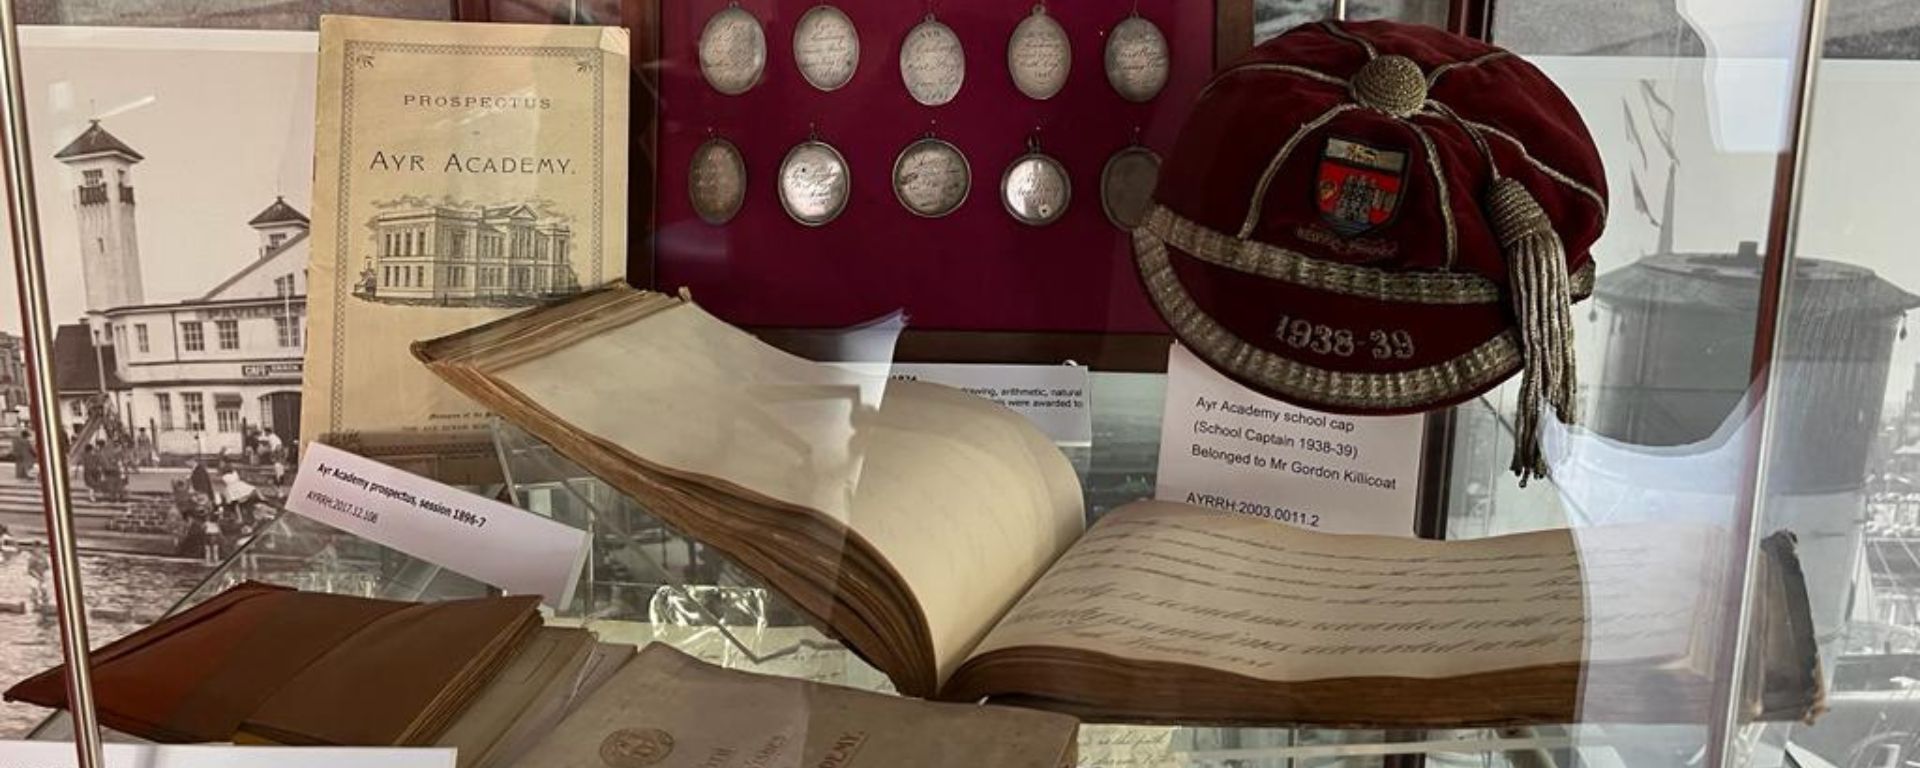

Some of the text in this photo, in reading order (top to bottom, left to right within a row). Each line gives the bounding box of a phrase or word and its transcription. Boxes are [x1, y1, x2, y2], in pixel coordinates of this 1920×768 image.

[403, 94, 552, 110] PROSPECTUS
[369, 150, 576, 175] AYR ACADEMY.
[1275, 315, 1415, 360] 1938-39
[1008, 400, 1029, 408] were
[1032, 399, 1071, 409] awarded
[1073, 400, 1083, 409] to
[1051, 388, 1082, 397] natural
[1196, 396, 1355, 433] Ayr Academy school cap
[1193, 420, 1359, 460] (School Captain 1938-39)
[1192, 444, 1397, 490] Belonged to Mr Gordon Killicoat
[317, 463, 487, 529] Ayr Academy prospectus, session 1896-7
